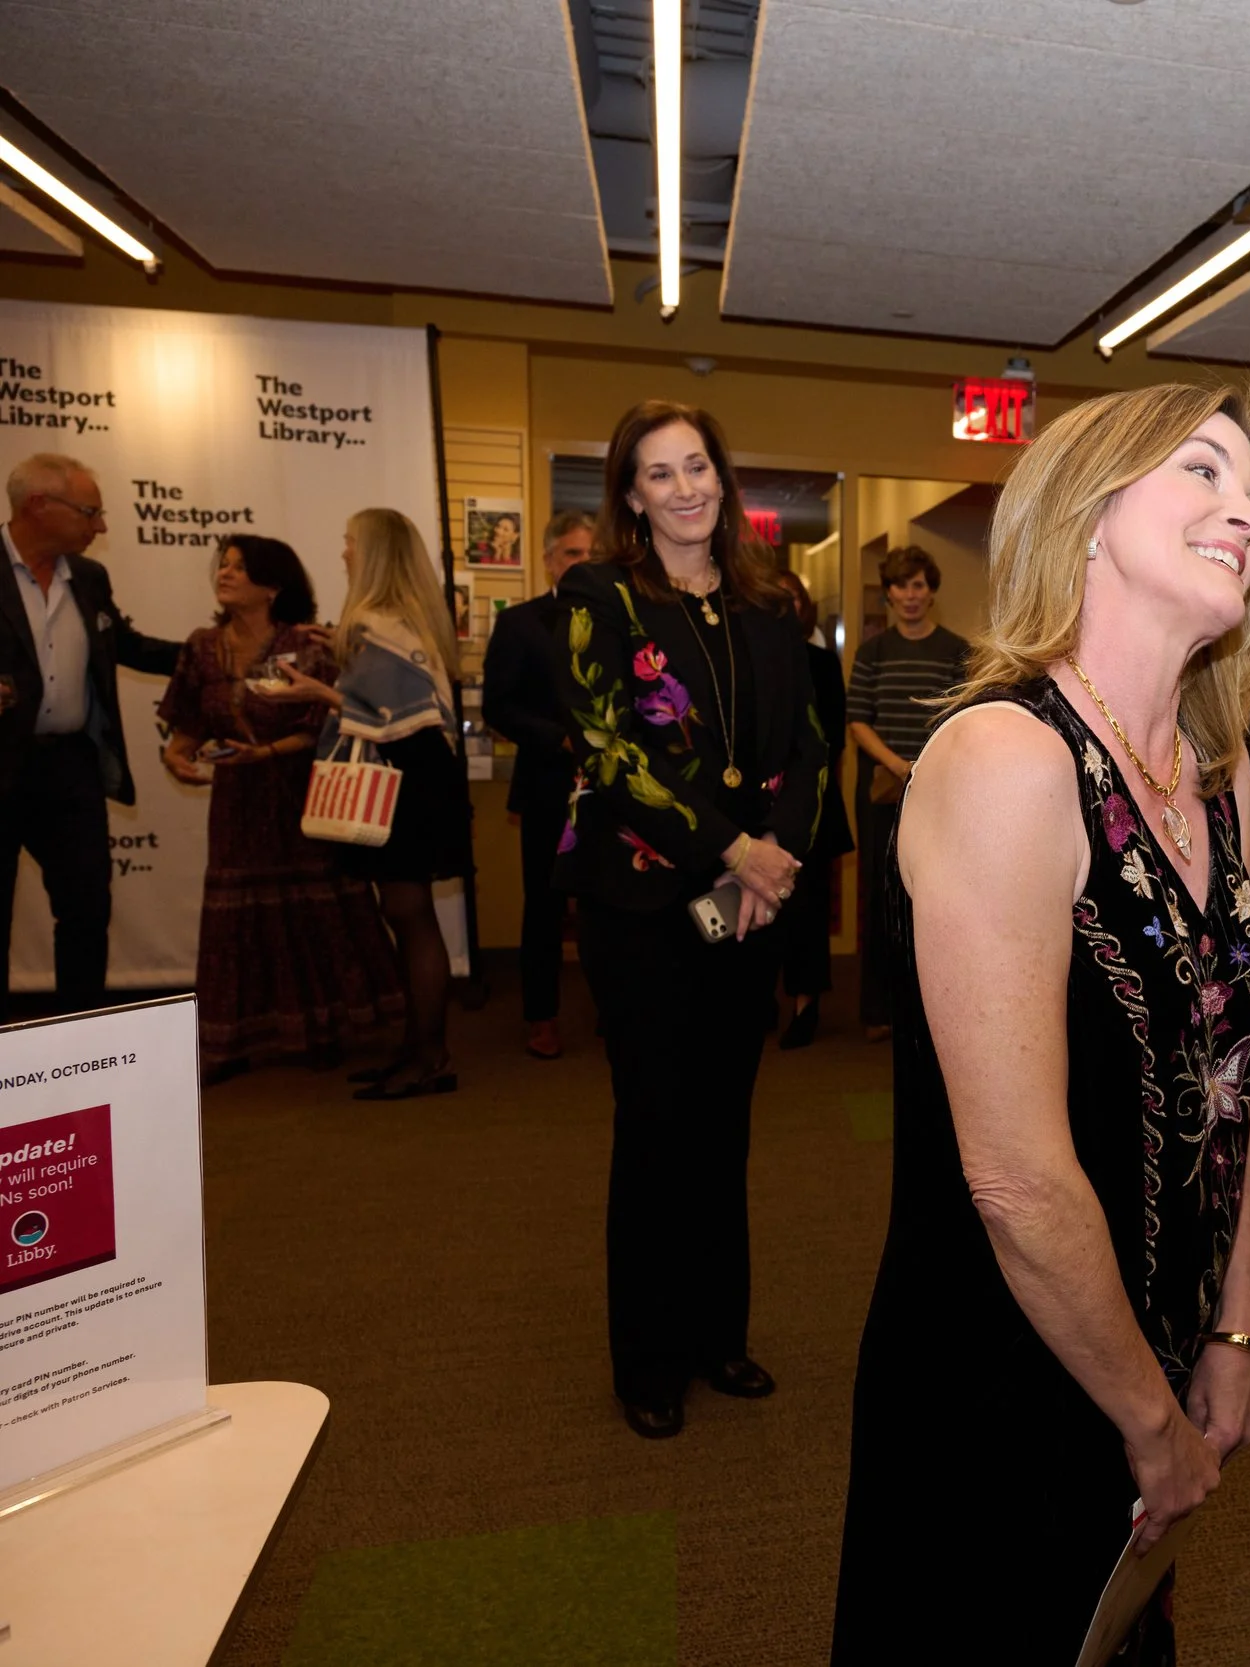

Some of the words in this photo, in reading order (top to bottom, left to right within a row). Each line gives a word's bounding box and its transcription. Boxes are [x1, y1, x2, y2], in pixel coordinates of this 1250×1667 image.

[0, 357, 42, 380] The
[0, 381, 116, 409] Westport
[255, 374, 303, 396] The
[257, 397, 372, 425] Westport
[964, 384, 1028, 438] EXIT
[259, 421, 366, 449] Library...
[131, 479, 183, 501] The
[133, 502, 255, 529] Westport
[0, 1071, 47, 1090] NDAY,
[51, 1056, 118, 1079] OCTOBER
[121, 1053, 137, 1065] 12
[8, 1167, 35, 1186] will
[40, 1154, 98, 1178] require
[28, 1176, 73, 1199] soon!
[6, 1244, 57, 1267] Libby.
[16, 1312, 32, 1324] PIN
[34, 1301, 69, 1318] number
[70, 1295, 87, 1305] will
[88, 1291, 99, 1300] be
[100, 1278, 136, 1296] required
[136, 1276, 146, 1284] to
[24, 1315, 63, 1332] account.
[65, 1308, 83, 1319] This
[85, 1297, 115, 1312] update
[116, 1293, 123, 1301] is
[125, 1290, 134, 1298] to
[134, 1281, 163, 1295] ensure
[26, 1330, 44, 1342] and
[45, 1320, 80, 1336] private.
[11, 1378, 33, 1391] card
[34, 1371, 50, 1383] PIN
[52, 1359, 88, 1377] number.
[13, 1387, 39, 1402] digits
[41, 1382, 50, 1392] of
[51, 1376, 71, 1390] your
[72, 1365, 100, 1382] phone
[101, 1352, 136, 1370] number.
[10, 1409, 39, 1425] check
[40, 1401, 60, 1414] with
[61, 1391, 90, 1406] Patron
[92, 1375, 131, 1394] Services.
